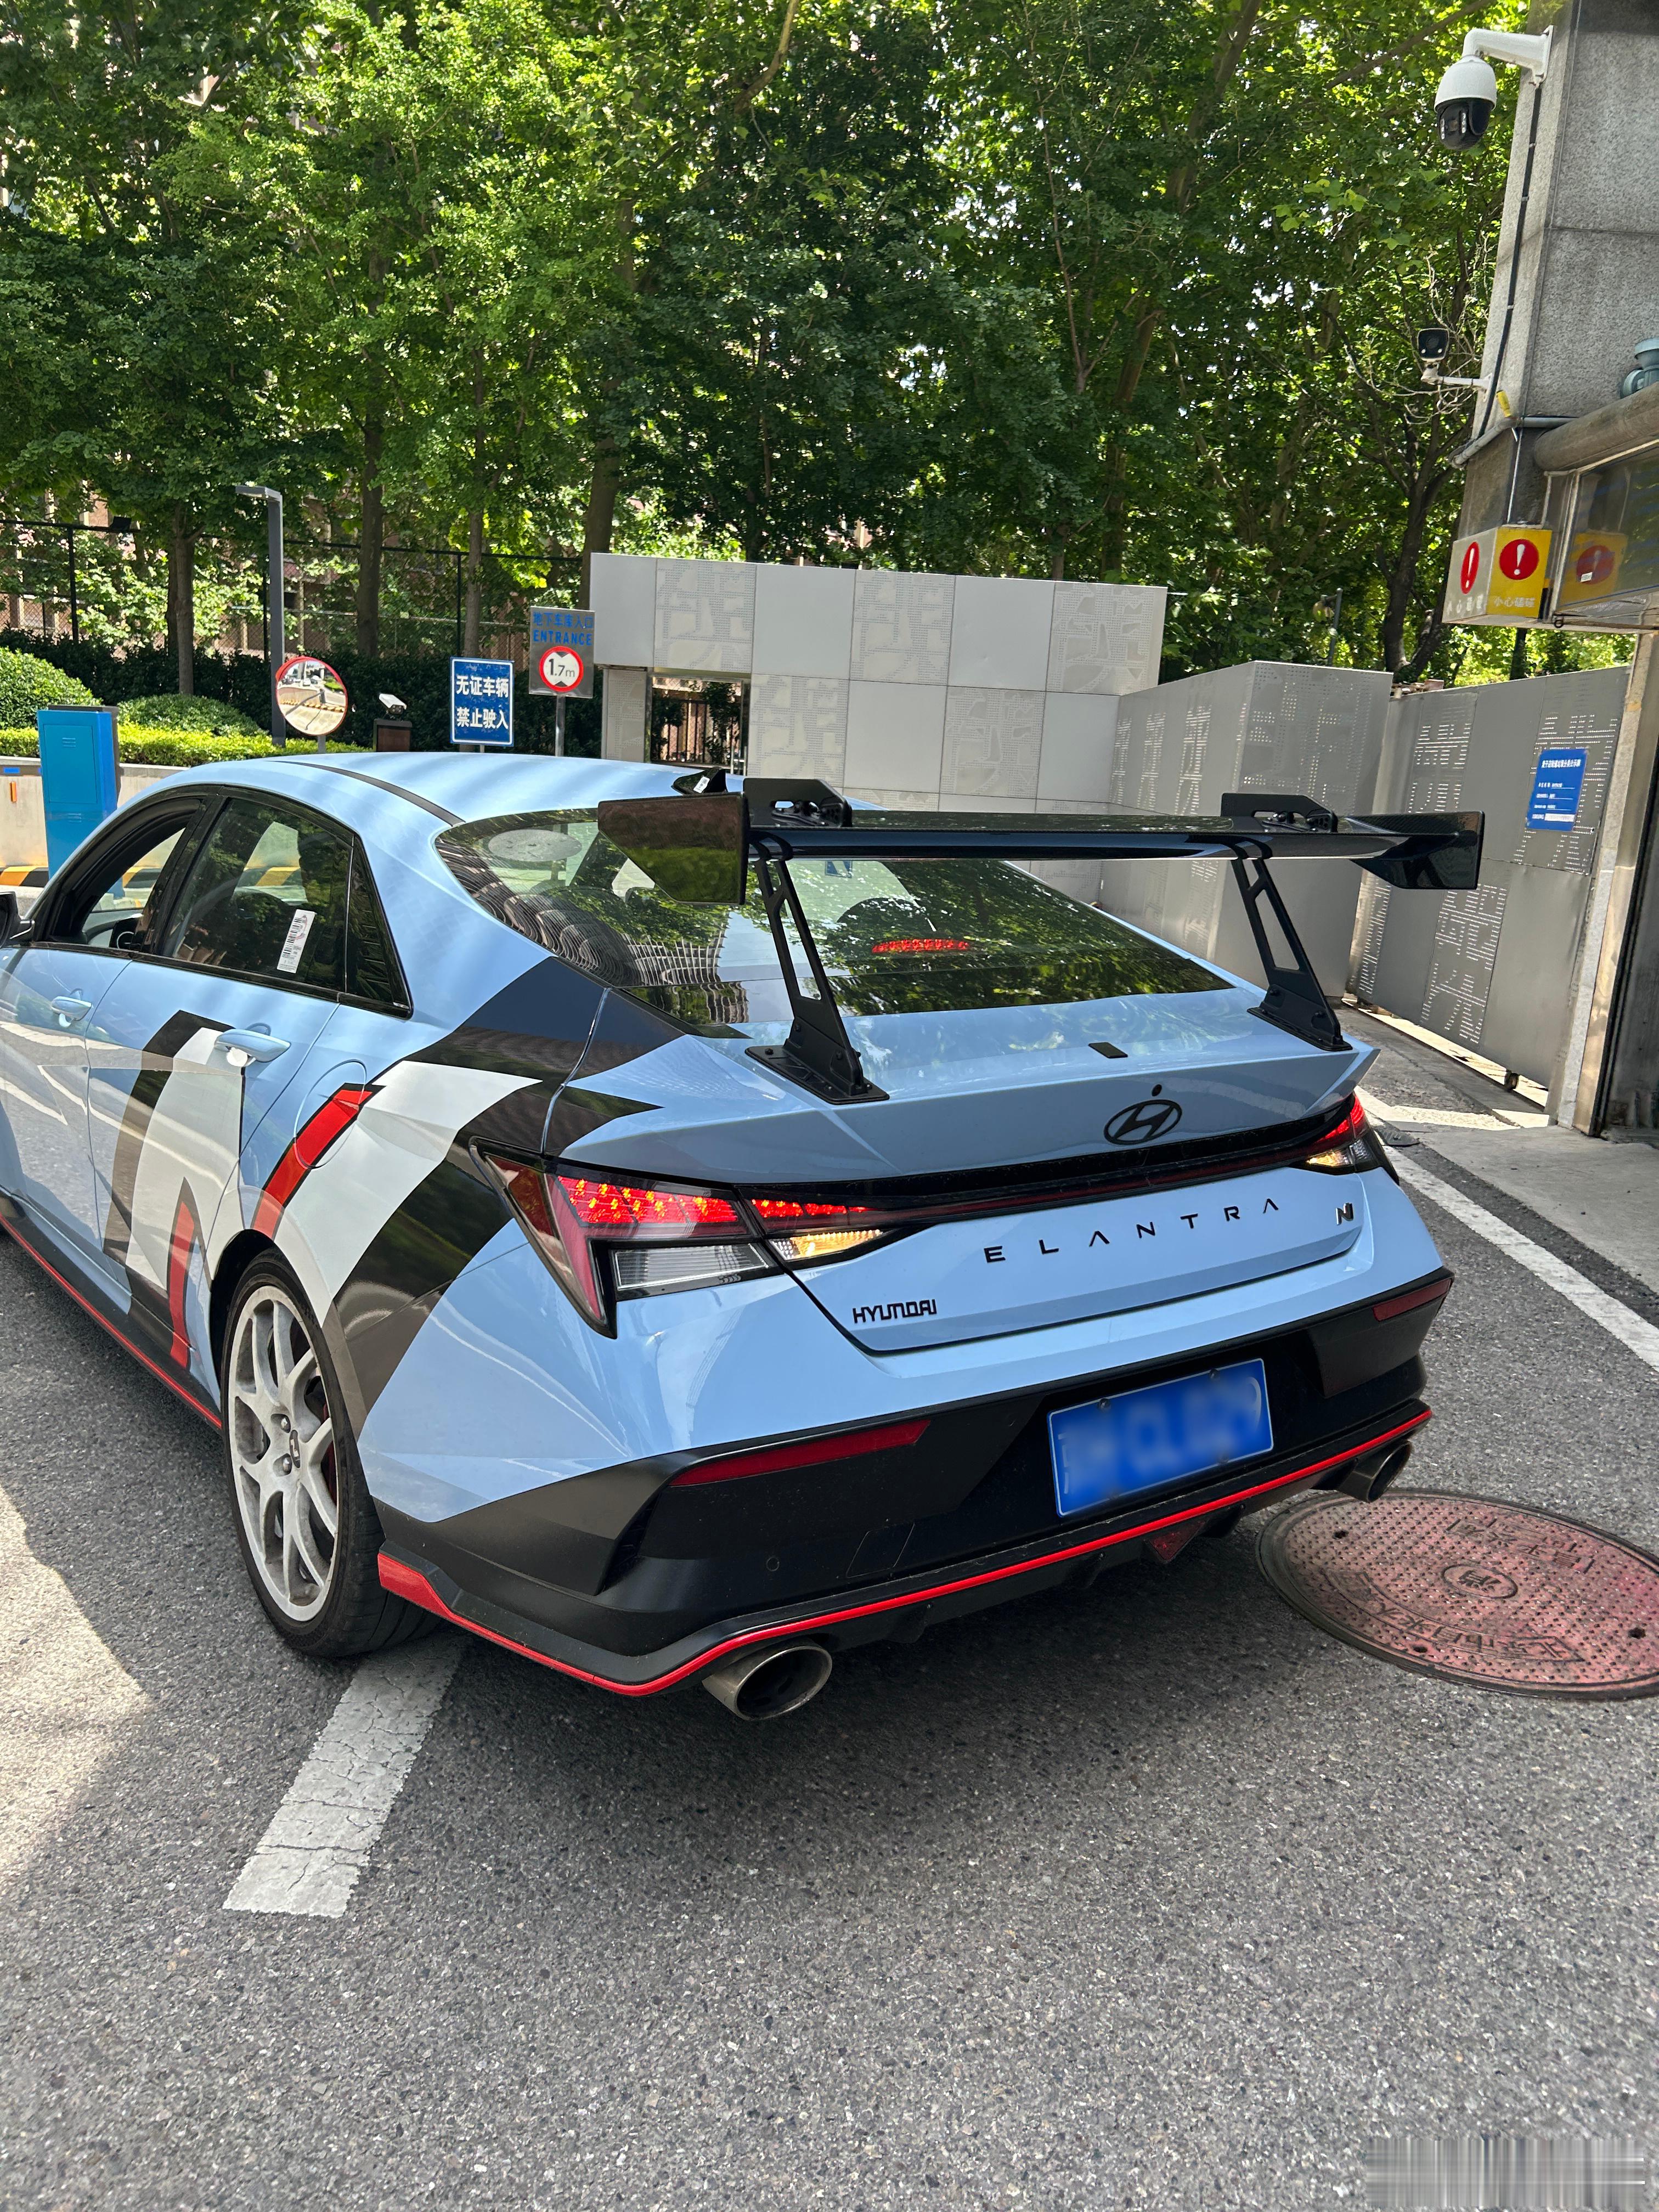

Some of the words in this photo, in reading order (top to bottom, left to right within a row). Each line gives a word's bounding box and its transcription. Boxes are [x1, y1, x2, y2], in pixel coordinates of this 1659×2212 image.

[533, 611, 594, 629] 地下车库入口
[533, 629, 593, 646] ENTRANCE
[548, 658, 575, 678] 1.7m
[456, 675, 509, 698] 无证车辆
[456, 706, 509, 730] 禁止驶入
[983, 1198, 1279, 1263] ELANTRA
[1335, 1202, 1355, 1226] N
[852, 1299, 937, 1324] HYUNDAI
